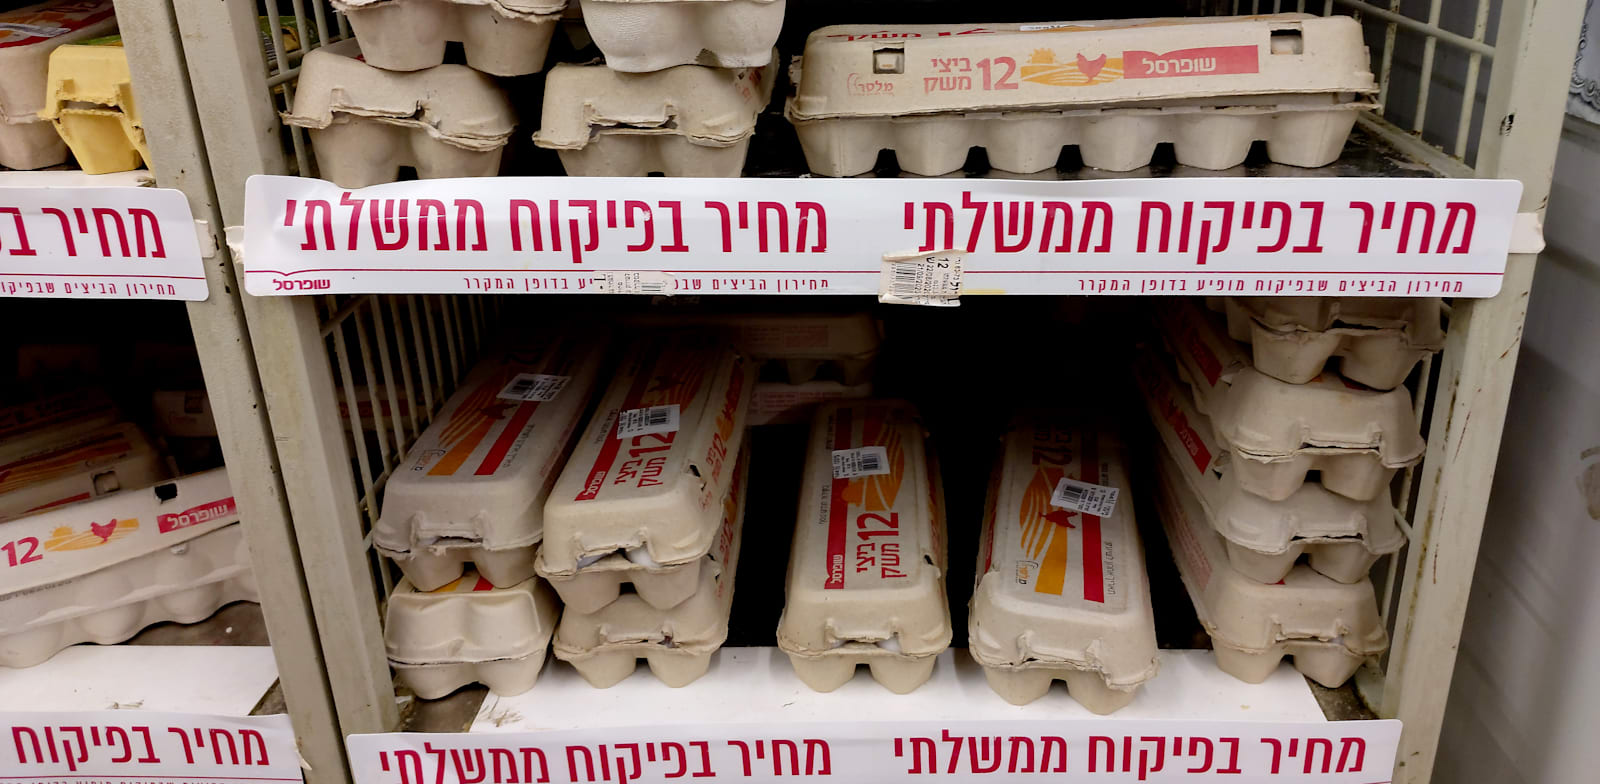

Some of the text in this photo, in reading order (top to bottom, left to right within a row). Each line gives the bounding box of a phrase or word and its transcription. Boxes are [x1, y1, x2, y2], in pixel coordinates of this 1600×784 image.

[930, 57, 972, 73] ביצי
[976, 57, 1019, 91] 12
[1142, 57, 1216, 75] שופרסל
[923, 75, 972, 95] משק
[41, 207, 167, 259] מחיר
[283, 191, 828, 264] מחיר בפיקוח ממשלתי
[903, 191, 1476, 265] מחיר בפיקוח ממשלתי
[937, 257, 949, 269] 12
[0, 281, 176, 297] מחירון הביצים שבפיקו
[272, 279, 331, 291] שופרסל
[464, 278, 514, 292] המקרר
[525, 278, 568, 292] בדופן
[712, 279, 767, 291] הביצים
[777, 279, 829, 293] מחירון
[1079, 279, 1463, 295] מחירון הביצים שבפיקוח מופיע בדופן המקרר
[167, 503, 229, 530] שופרסל
[856, 512, 900, 541] 12
[1, 536, 43, 567] 12
[856, 542, 876, 573] ביצי
[880, 543, 908, 579] משק
[829, 554, 844, 585] שופרסל
[11, 726, 270, 772] מחיר בפיקוח
[379, 738, 832, 784] מחיר בפיקוח ממשלתי
[894, 729, 1366, 781] מחיר בפיקוח ממשלתי
